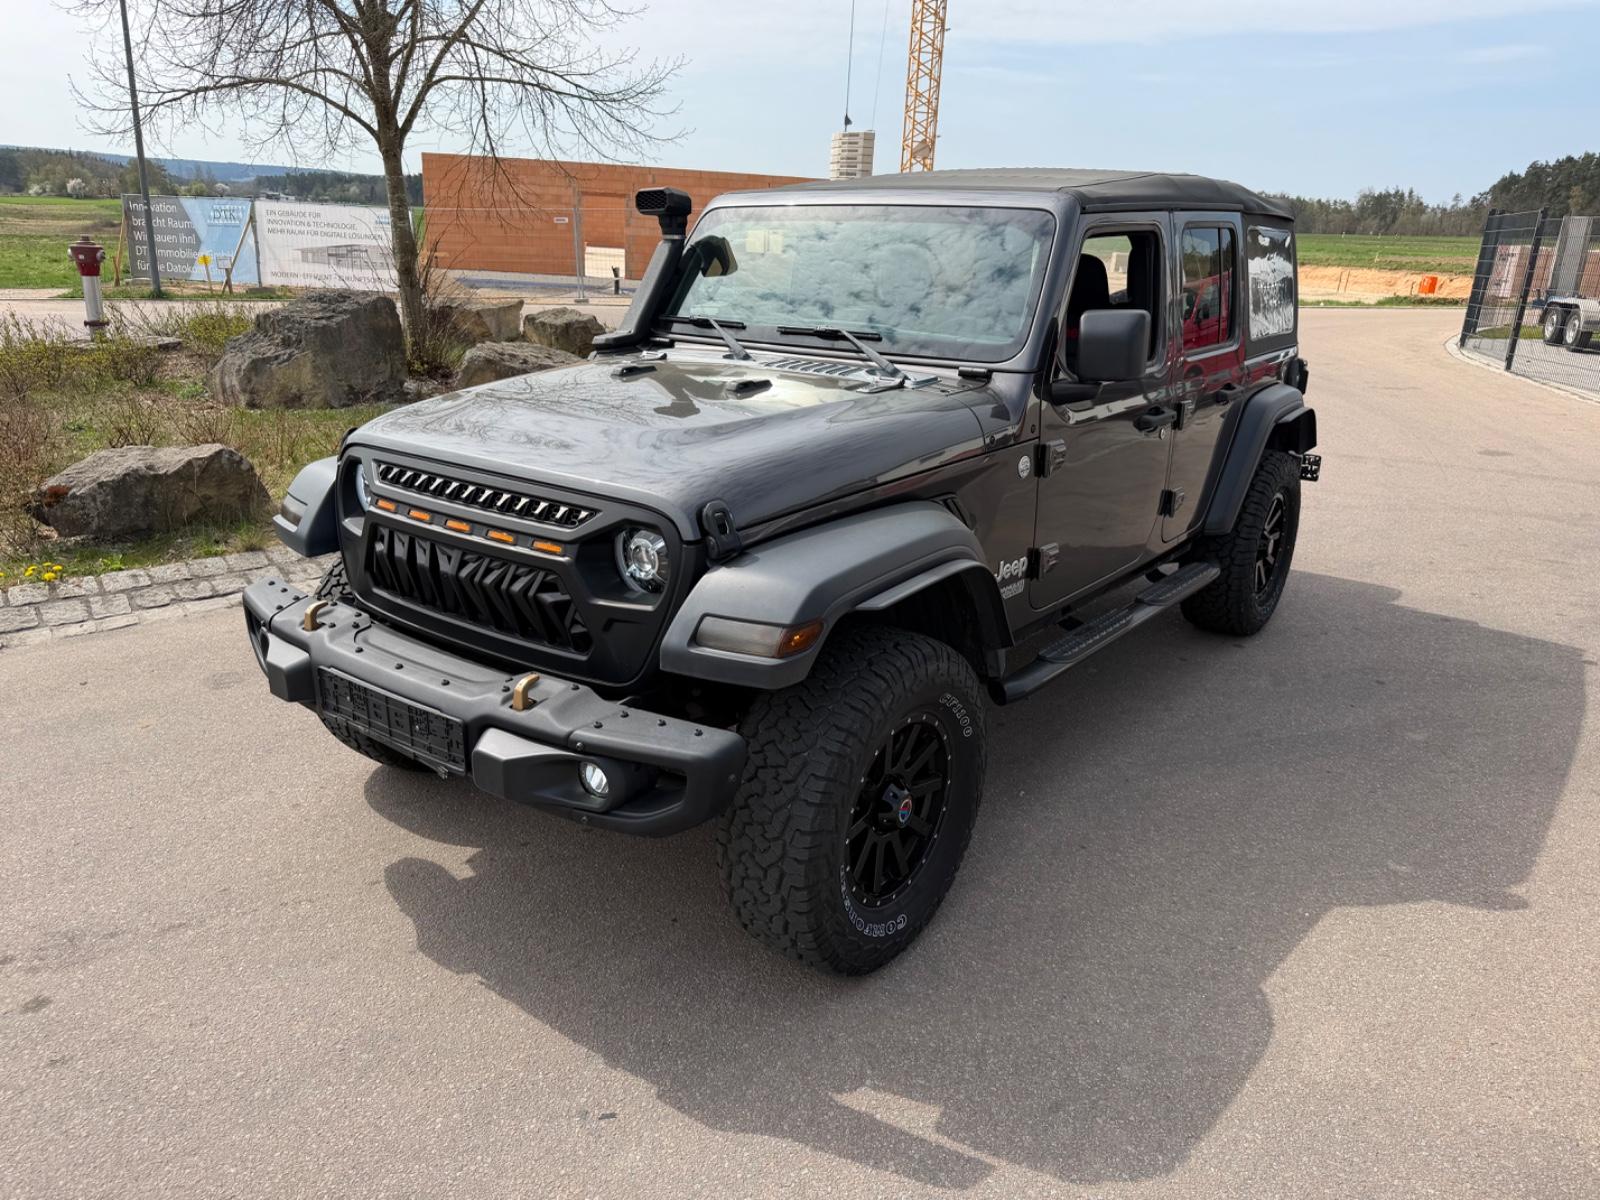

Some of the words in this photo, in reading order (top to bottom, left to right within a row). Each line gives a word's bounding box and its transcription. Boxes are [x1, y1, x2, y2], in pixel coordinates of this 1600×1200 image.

[129, 201, 177, 214] Innvation
[265, 209, 278, 217] EIN
[278, 208, 307, 218] GEBÄUDE
[131, 215, 166, 228] bracht
[267, 218, 306, 227] INNOVATION
[267, 227, 286, 236] MEHR
[286, 228, 306, 236] RAUM
[306, 229, 319, 237] FÜR
[320, 230, 347, 239] DIGITALE
[994, 556, 1028, 582] Jeep
